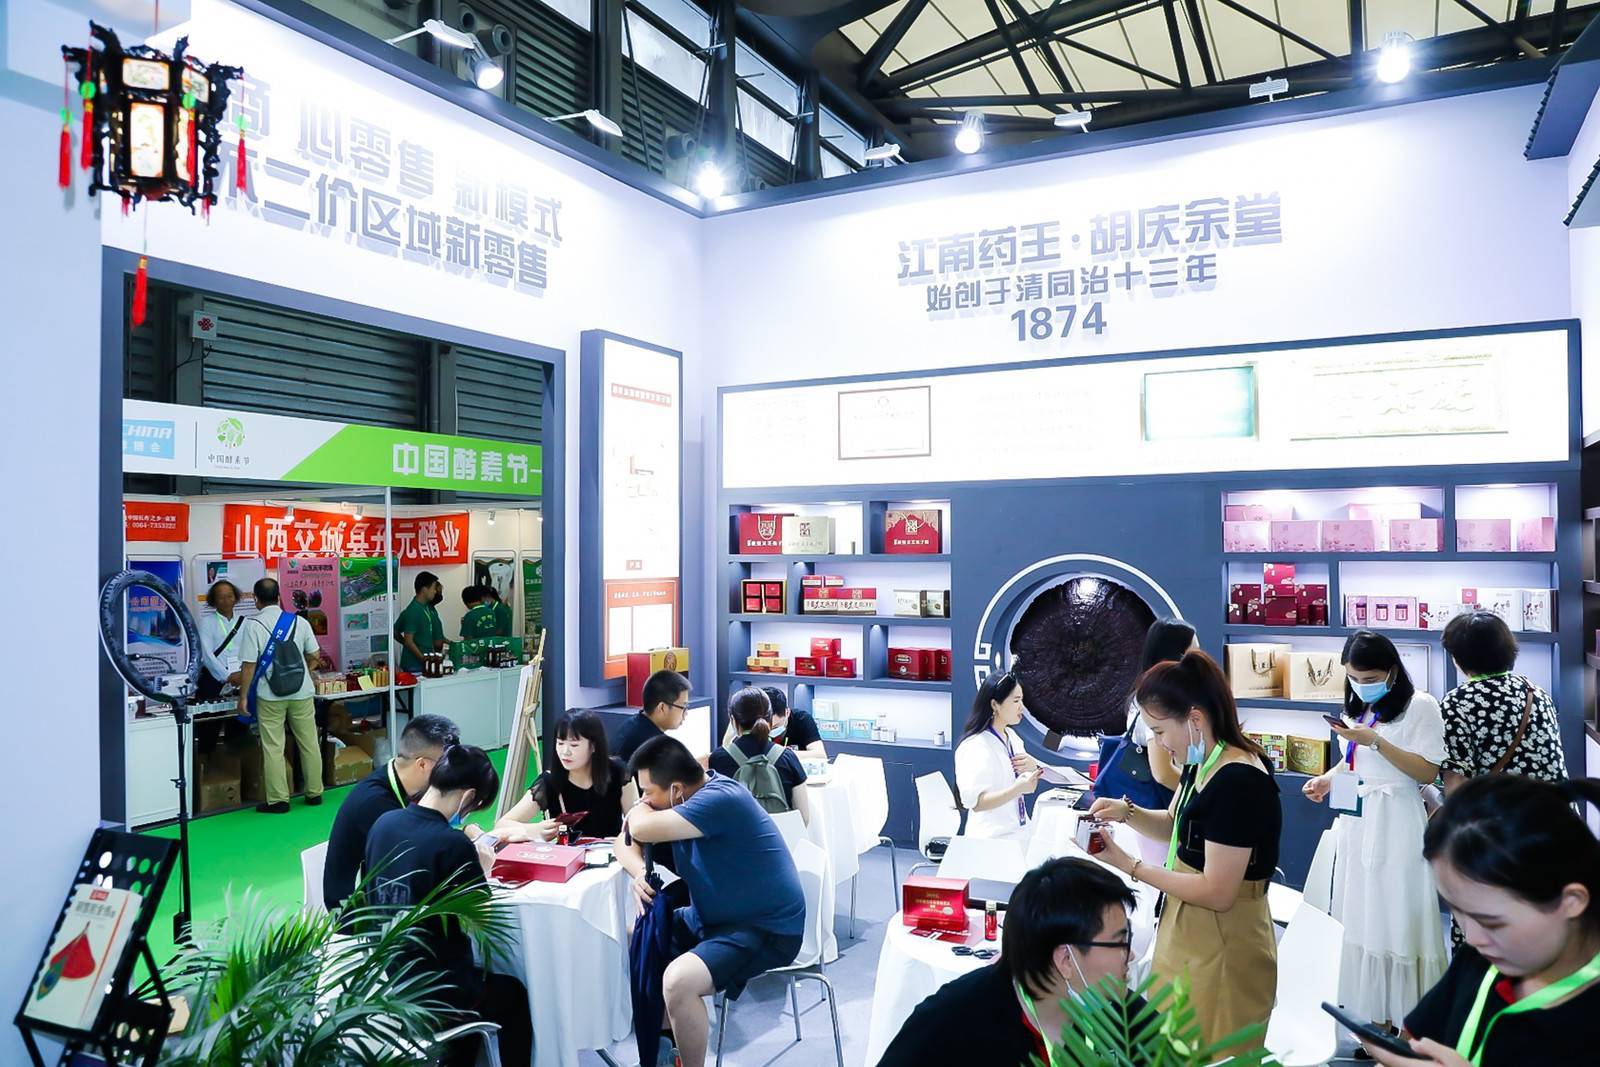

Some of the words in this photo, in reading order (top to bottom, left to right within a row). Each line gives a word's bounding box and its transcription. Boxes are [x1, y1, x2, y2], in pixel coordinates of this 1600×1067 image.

[897, 192, 1282, 279] 江南药王·胡庆余堂
[926, 253, 1217, 313] 始创于清同治十三年
[1011, 302, 1108, 342] 1874
[208, 453, 250, 466] 中国酵素节
